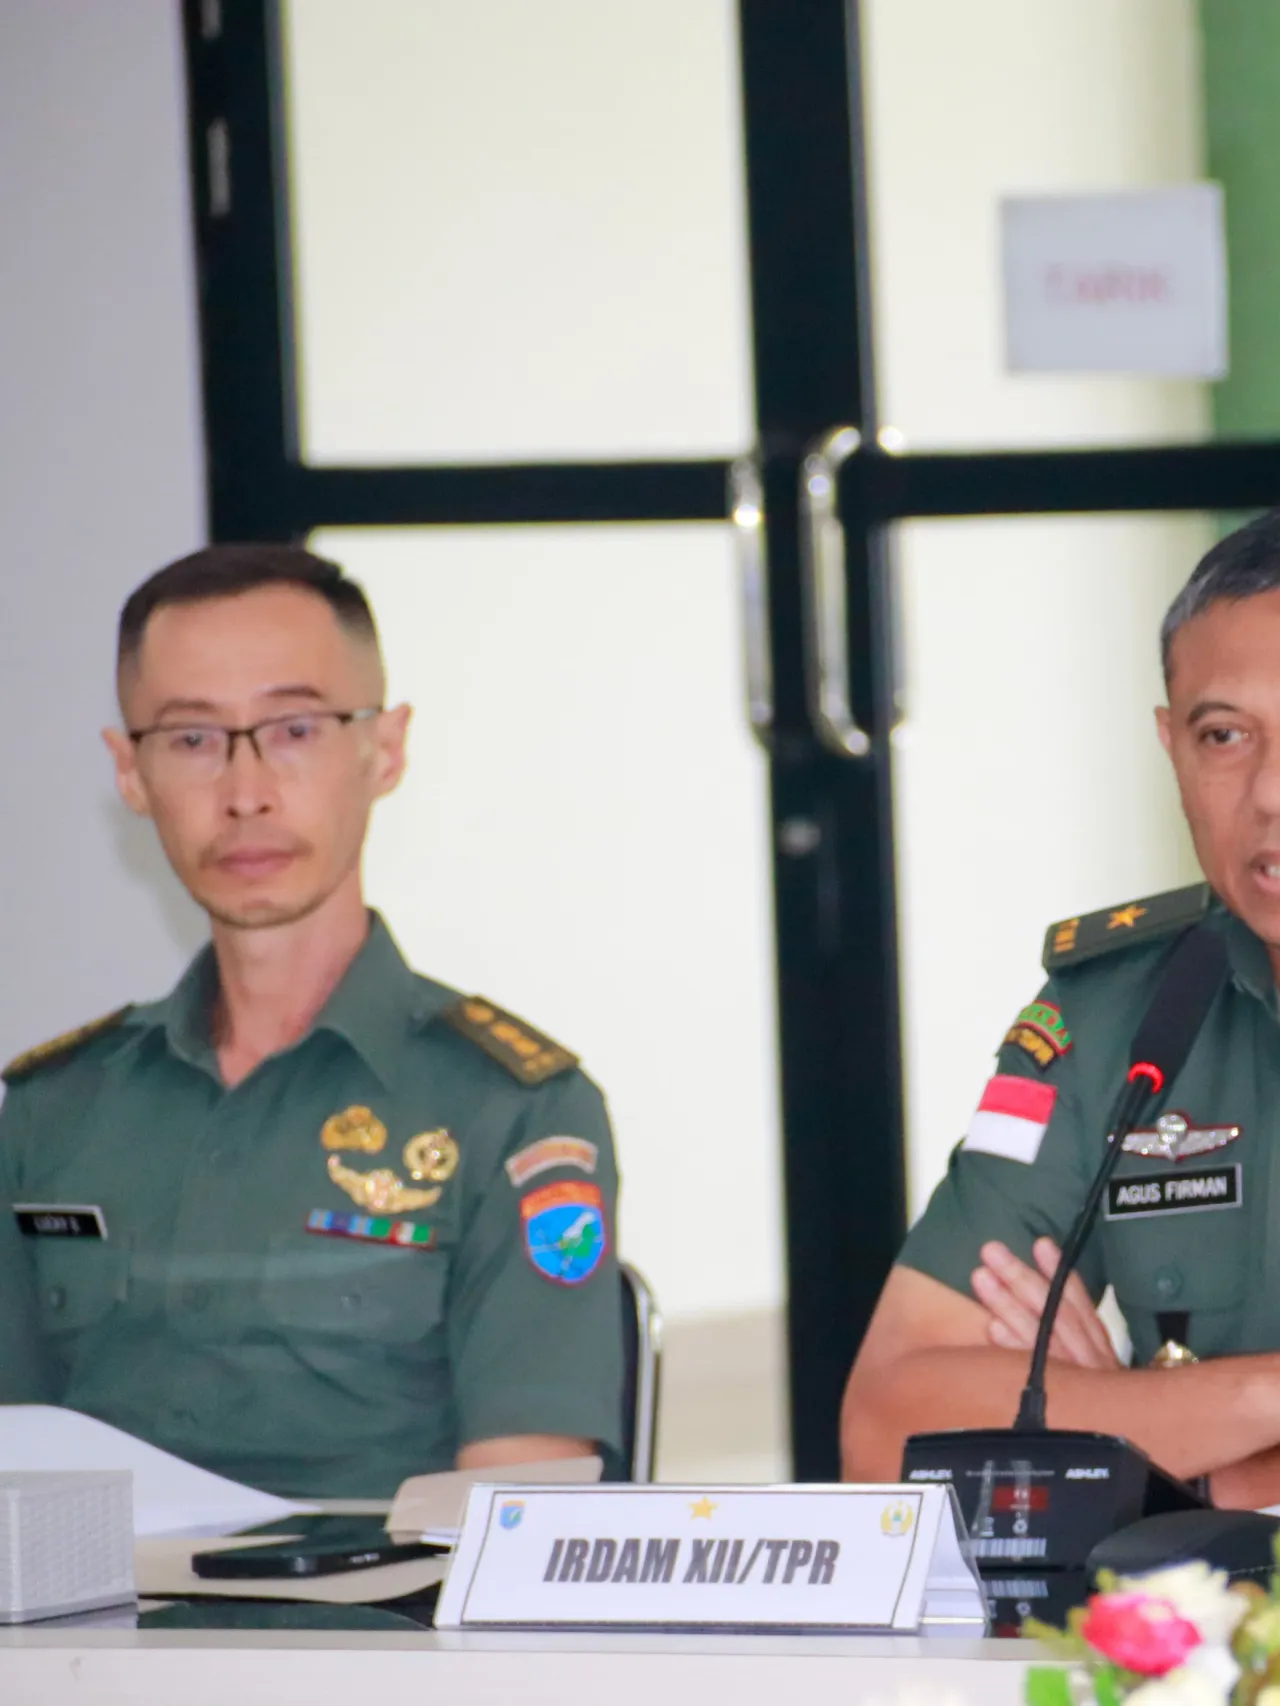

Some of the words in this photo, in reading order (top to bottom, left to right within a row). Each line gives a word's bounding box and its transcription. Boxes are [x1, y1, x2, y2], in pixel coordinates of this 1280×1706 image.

[1116, 1183, 1161, 1206] AGUS
[1165, 1176, 1227, 1201] FIRMAN
[544, 1539, 679, 1582] IRDAM
[684, 1539, 840, 1584] XII/TPR
